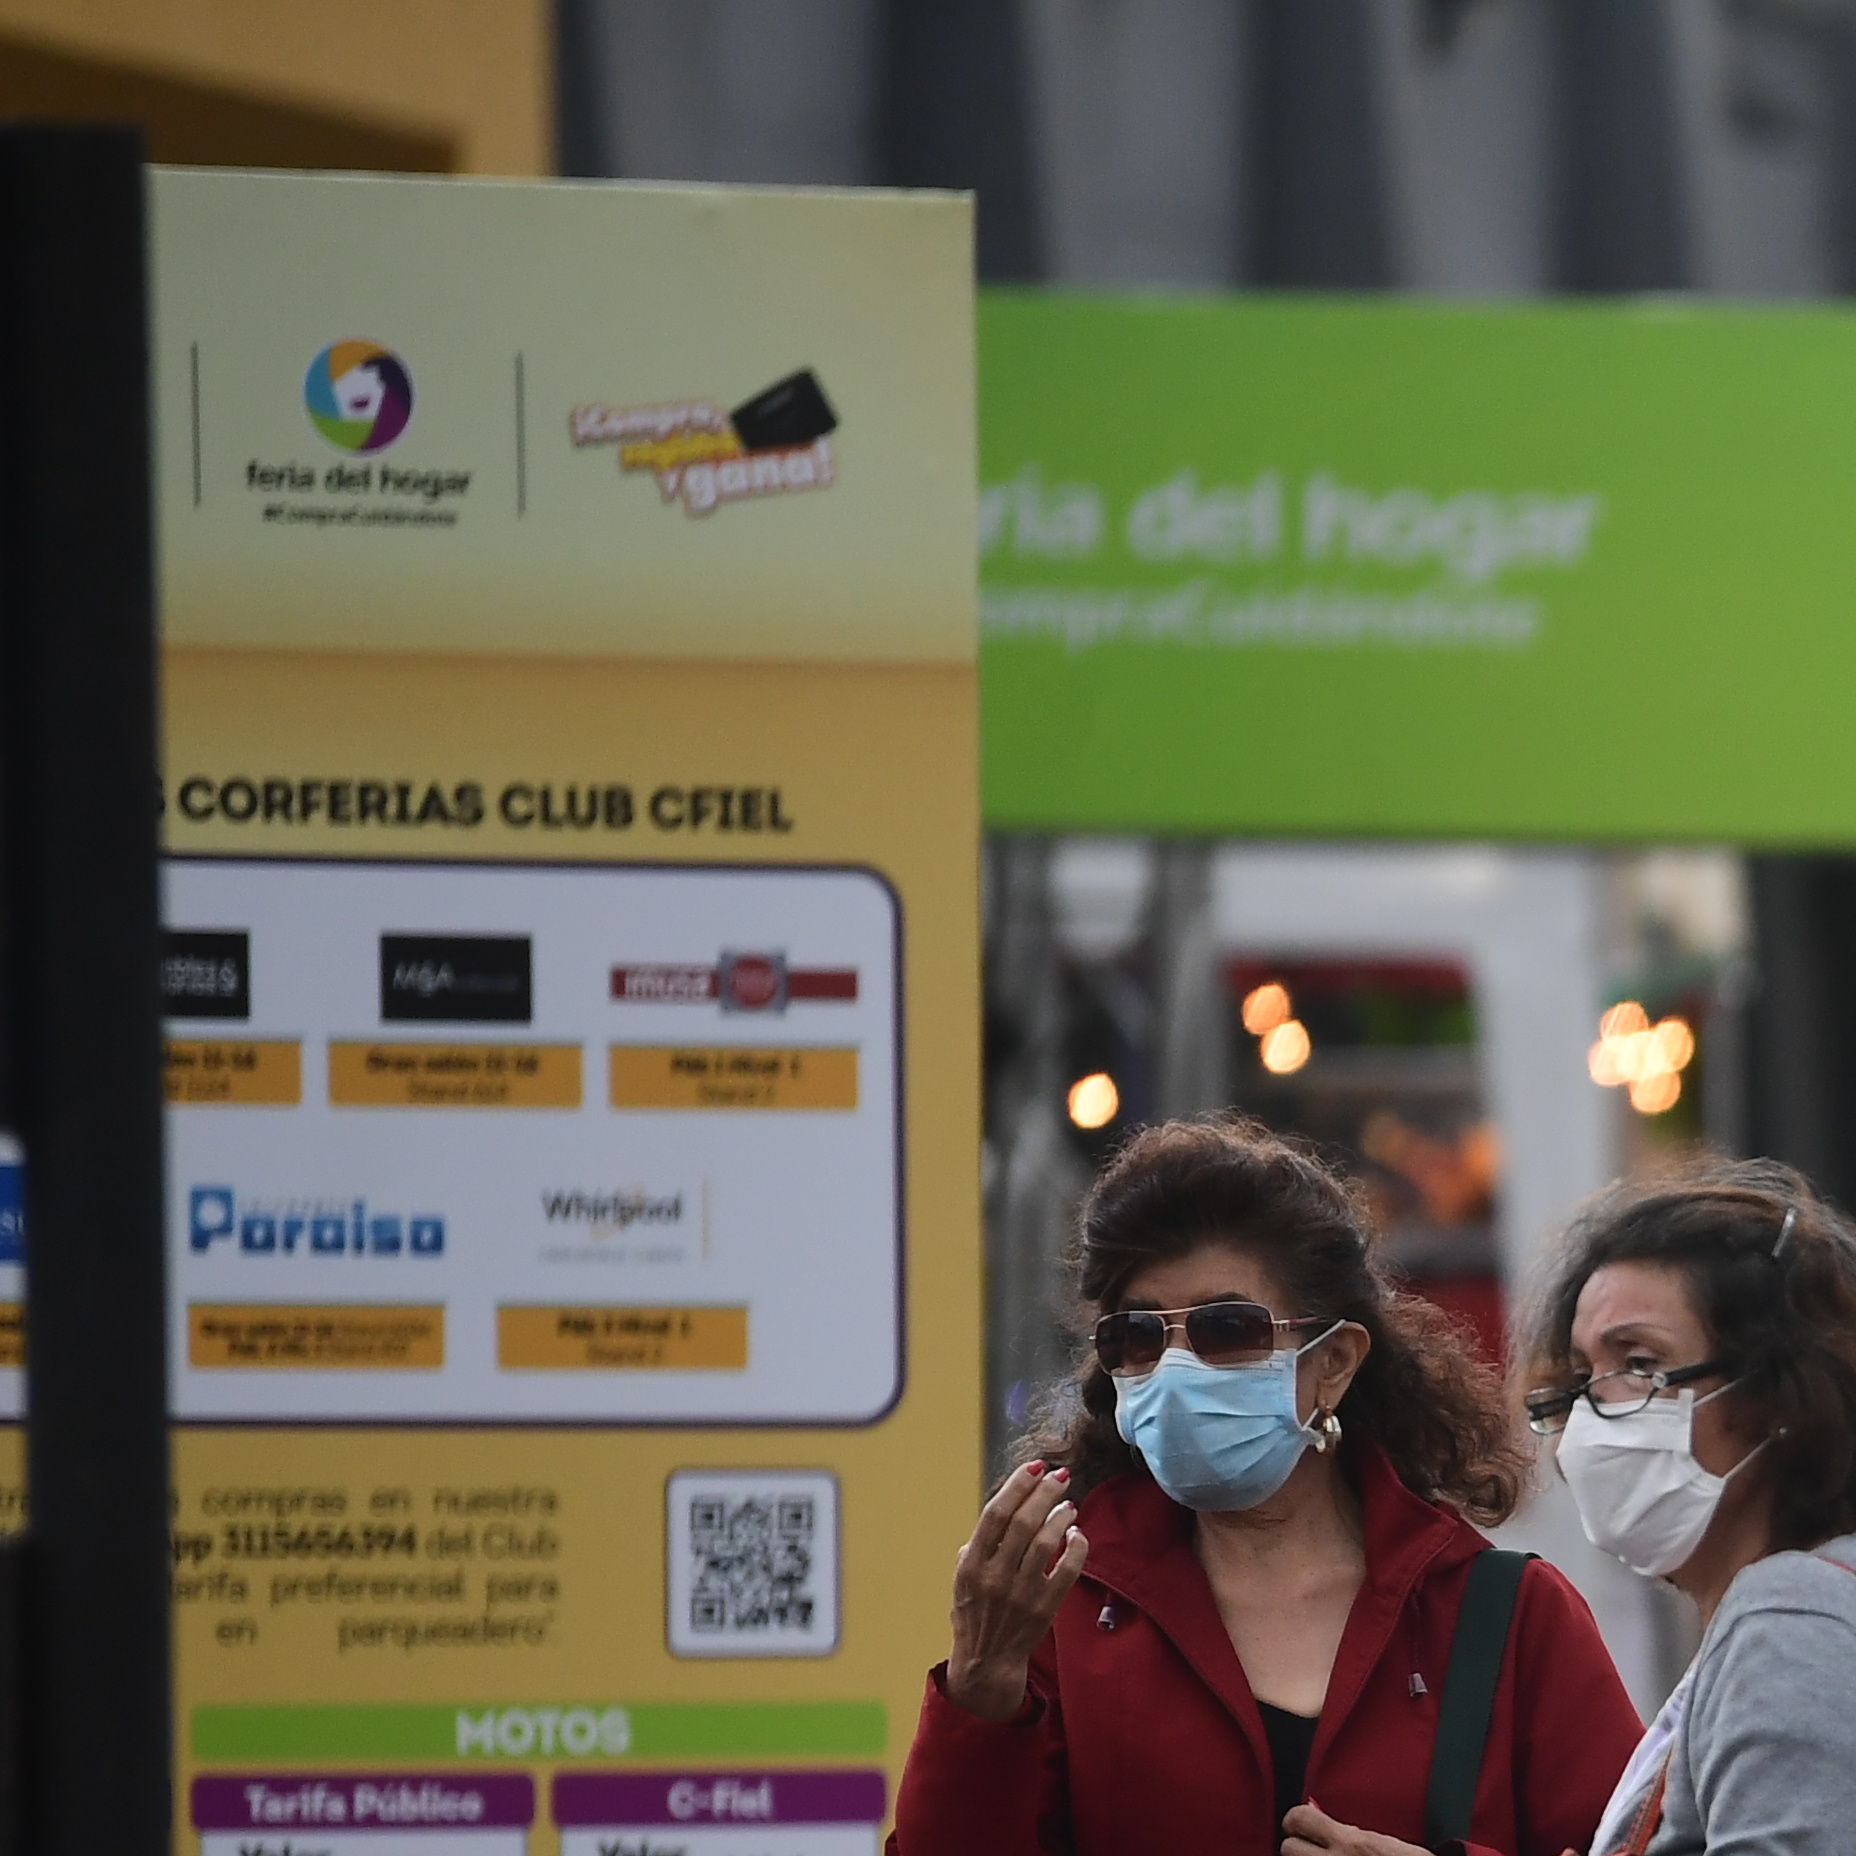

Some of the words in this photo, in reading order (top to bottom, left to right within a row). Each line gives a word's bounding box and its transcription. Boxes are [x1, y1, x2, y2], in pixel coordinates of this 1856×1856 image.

[247, 458, 315, 492] feria
[324, 462, 370, 493] del
[380, 463, 471, 504] hogar
[1126, 466, 1282, 564] del
[1303, 470, 1600, 582] hogar
[178, 774, 484, 827] CORFERIAS
[498, 781, 635, 829] CLUB
[648, 784, 793, 833] CFIEL
[190, 1186, 446, 1257] Paraiso
[541, 1190, 682, 1228] Whirlpool
[203, 1487, 351, 1521] compras
[369, 1489, 410, 1515] en
[433, 1487, 558, 1515] nuestra
[222, 1523, 417, 1559] 3115656394
[426, 1524, 473, 1558] del
[483, 1523, 559, 1559] Club
[270, 1570, 464, 1609] preferencial
[486, 1576, 559, 1609] para
[215, 1619, 257, 1647] en
[456, 1709, 631, 1755] MOTOS
[246, 1785, 346, 1822] Tarifa
[355, 1783, 482, 1821] Público
